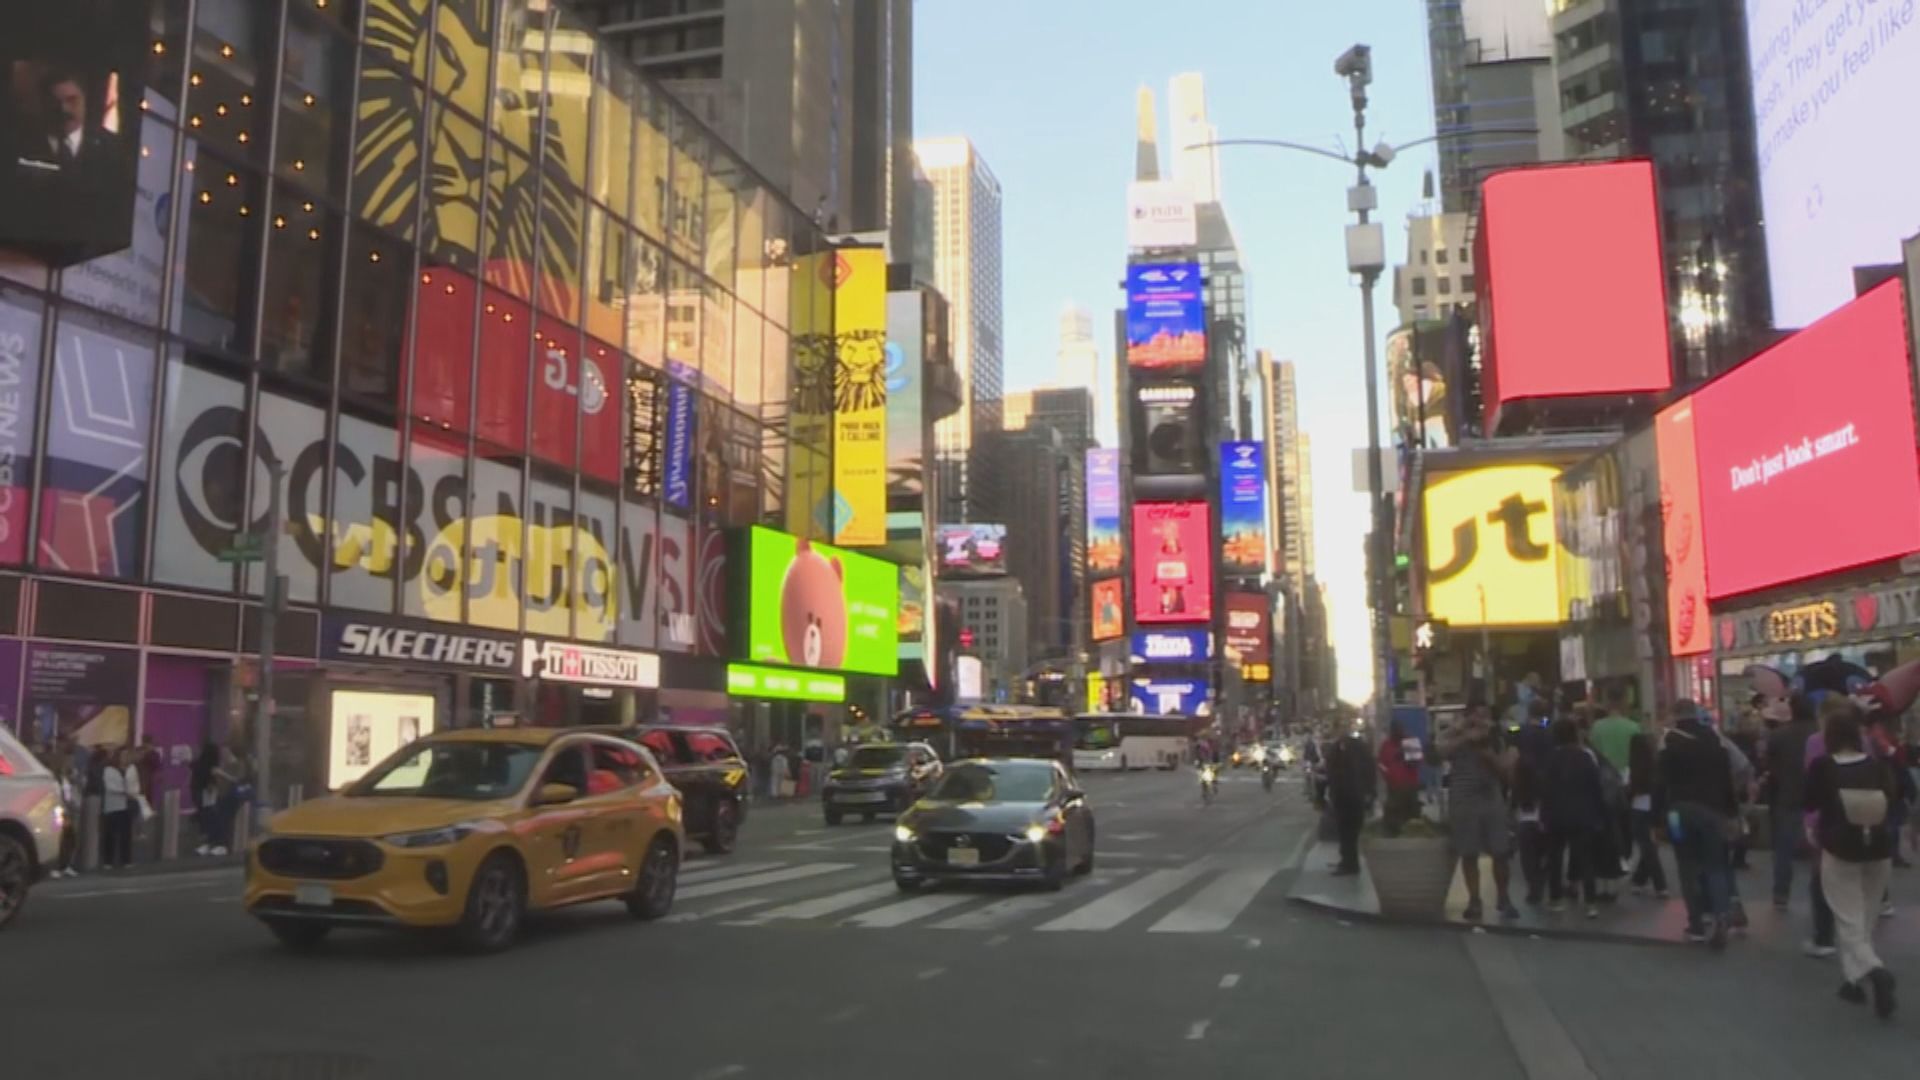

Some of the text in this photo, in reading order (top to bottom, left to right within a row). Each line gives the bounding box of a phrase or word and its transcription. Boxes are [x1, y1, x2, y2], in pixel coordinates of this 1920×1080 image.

[1730, 421, 1860, 492] Don't just look smart.
[1769, 601, 1840, 645] GIFTS
[338, 623, 516, 669] SKECHERS
[583, 653, 637, 681] TISSOT
